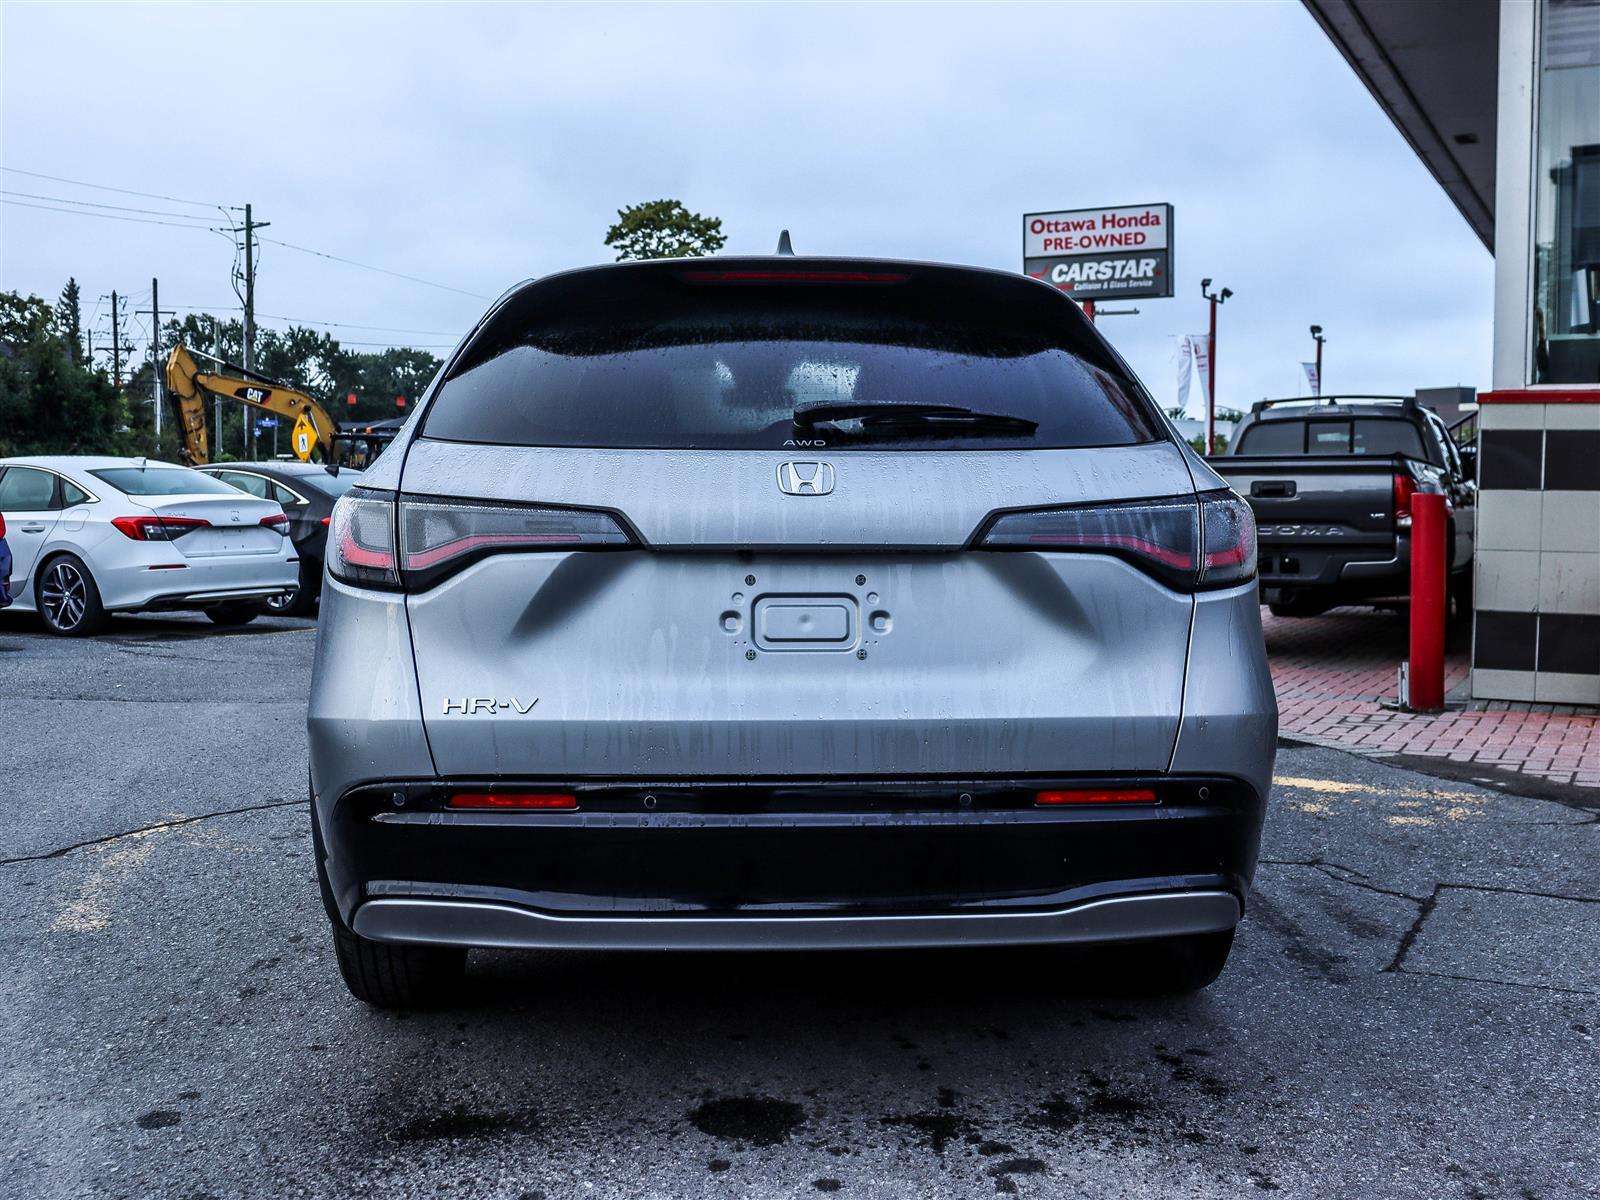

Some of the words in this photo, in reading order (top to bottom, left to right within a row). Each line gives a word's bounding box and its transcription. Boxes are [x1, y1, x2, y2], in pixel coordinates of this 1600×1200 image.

[1030, 217, 1096, 235] Ottawa
[1101, 211, 1161, 229] Honda
[1044, 232, 1146, 251] PRE-OWNED
[1051, 258, 1157, 283] CARSTAR
[246, 387, 263, 403] CAT
[442, 697, 539, 714] HR-V
